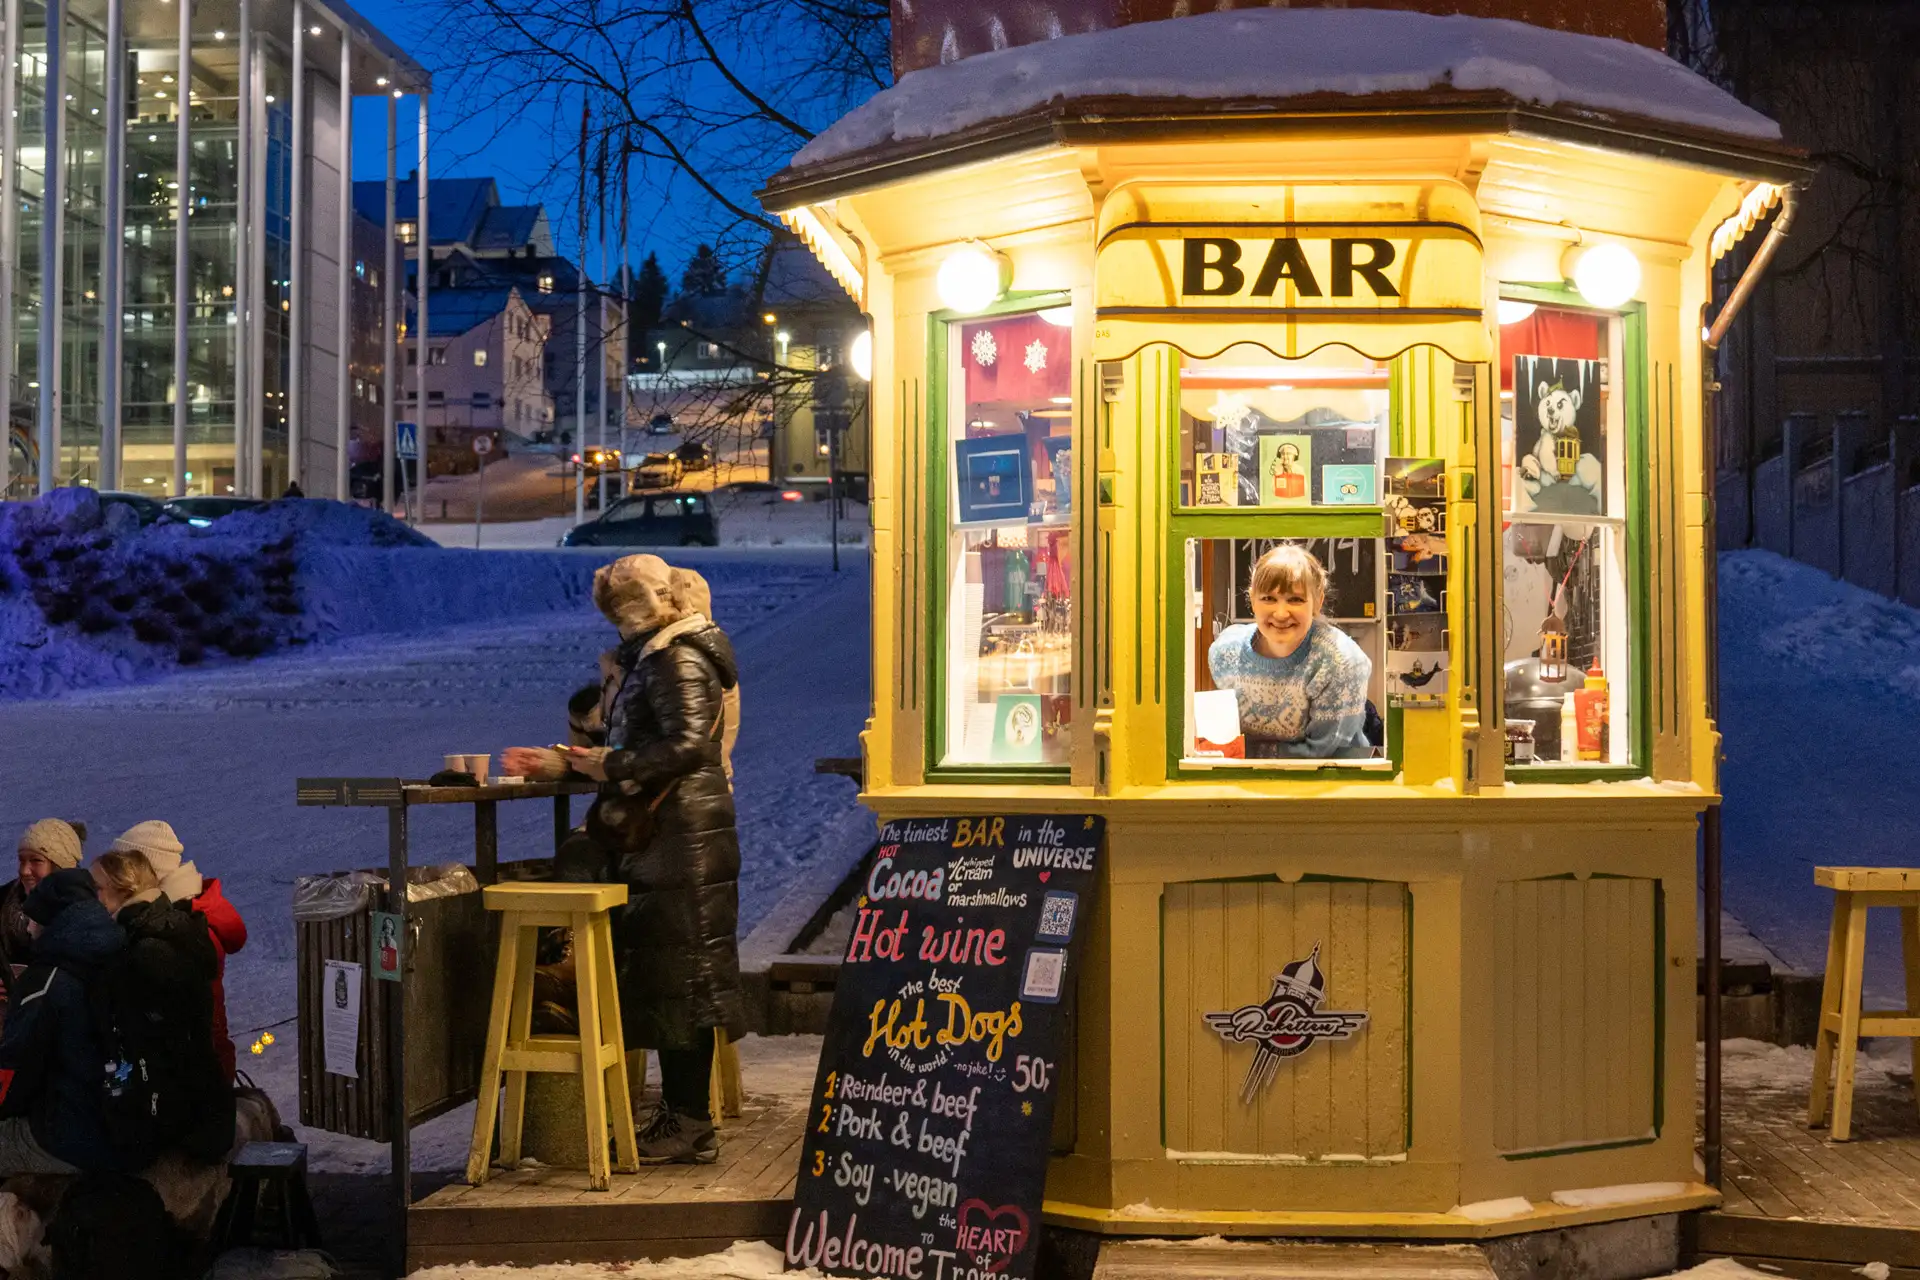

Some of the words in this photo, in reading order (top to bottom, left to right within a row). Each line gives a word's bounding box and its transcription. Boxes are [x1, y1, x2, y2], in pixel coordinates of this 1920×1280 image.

[1182, 237, 1400, 297] BAR
[880, 823, 901, 842] The
[903, 819, 949, 843] tiniest
[952, 817, 1005, 848] BAR
[1018, 824, 1032, 842] in
[1038, 819, 1065, 847] the
[878, 844, 900, 859] HOT
[963, 855, 995, 868] whipped
[1012, 847, 1096, 871] UNIVERSE
[868, 857, 945, 902] Cocoa
[947, 882, 963, 893] or
[955, 866, 993, 881] Cream
[947, 887, 1027, 907] marshmallows
[846, 908, 909, 963] Hot
[919, 916, 1008, 966] wine
[928, 968, 964, 994] best
[863, 998, 932, 1058] Hot
[936, 993, 1023, 1062] Dogs
[887, 1047, 900, 1062] in
[899, 1057, 915, 1073] the
[918, 1043, 955, 1073] world!
[966, 1062, 993, 1079] joke!
[824, 1071, 840, 1098] 1:
[840, 1072, 911, 1107] Reindeer
[911, 1079, 928, 1108] &
[931, 1085, 981, 1130] beef
[818, 1104, 836, 1133] 2:
[836, 1104, 883, 1141] Pork
[890, 1111, 912, 1149] &
[918, 1118, 970, 1177] beef
[812, 1151, 833, 1177] 3:
[834, 1152, 875, 1206] Soy
[939, 1213, 957, 1229] the
[786, 1207, 923, 1279] Welcome
[955, 1225, 1021, 1255] HEART
[976, 1253, 992, 1270] of
